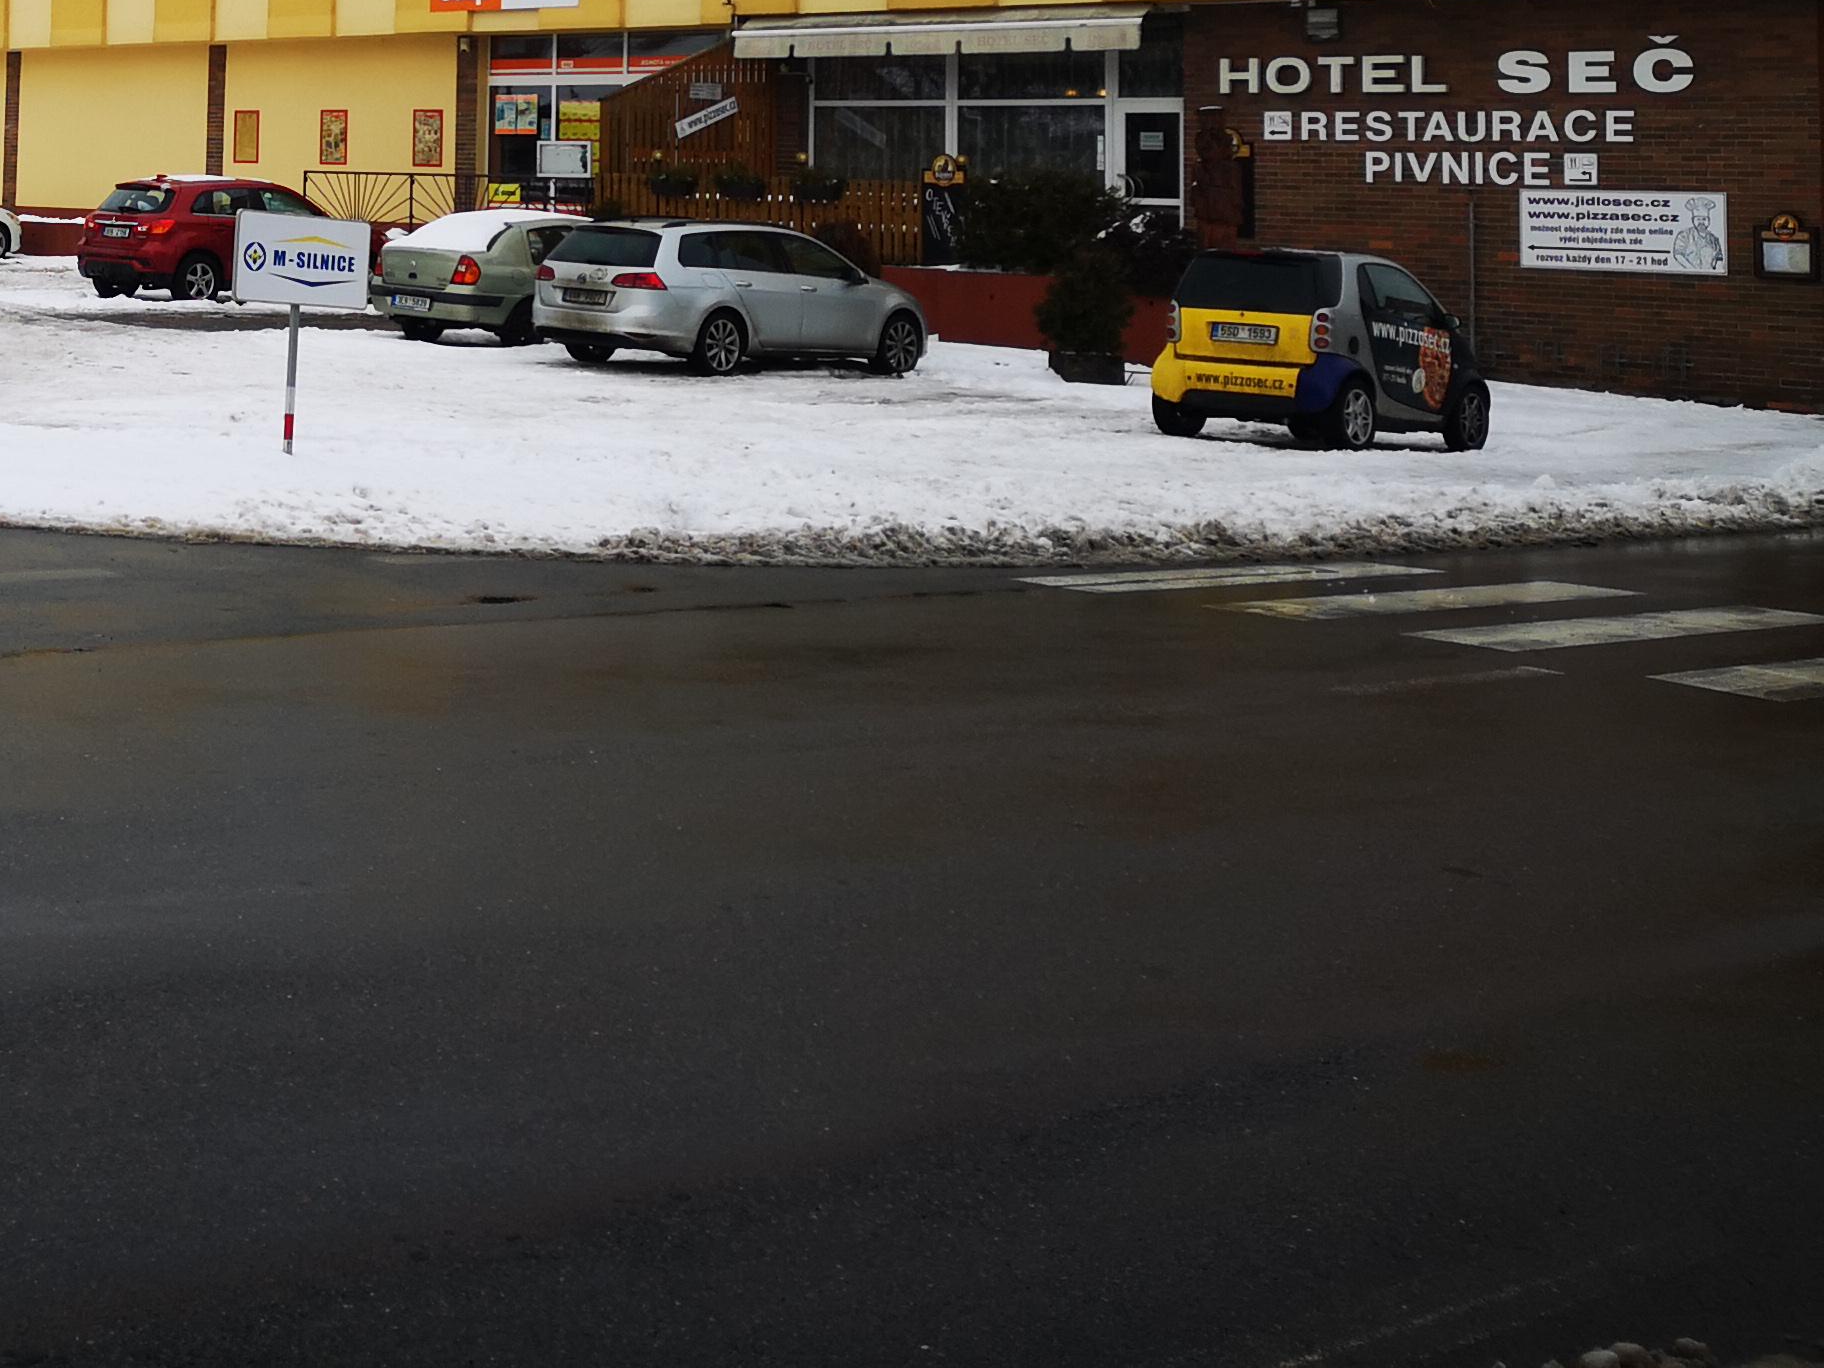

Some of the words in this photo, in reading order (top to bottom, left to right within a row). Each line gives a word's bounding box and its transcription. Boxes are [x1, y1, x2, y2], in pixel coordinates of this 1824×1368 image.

[1218, 55, 1449, 95] HOTEL
[1497, 34, 1695, 95] SEČ
[1299, 109, 1636, 144] RESTAURACE
[1364, 151, 1552, 187] PIVNICE
[1527, 195, 1671, 208] www.jidlosec.cz
[1527, 210, 1680, 222] www.pizzasec.cz
[1536, 254, 1564, 262] rozvoz
[1566, 253, 1592, 265] každý
[1595, 255, 1615, 264] den
[1616, 256, 1626, 265] 17
[1636, 256, 1648, 265] 21
[1651, 256, 1669, 266] hod
[1195, 371, 1285, 390] www.pizzasec.cz
